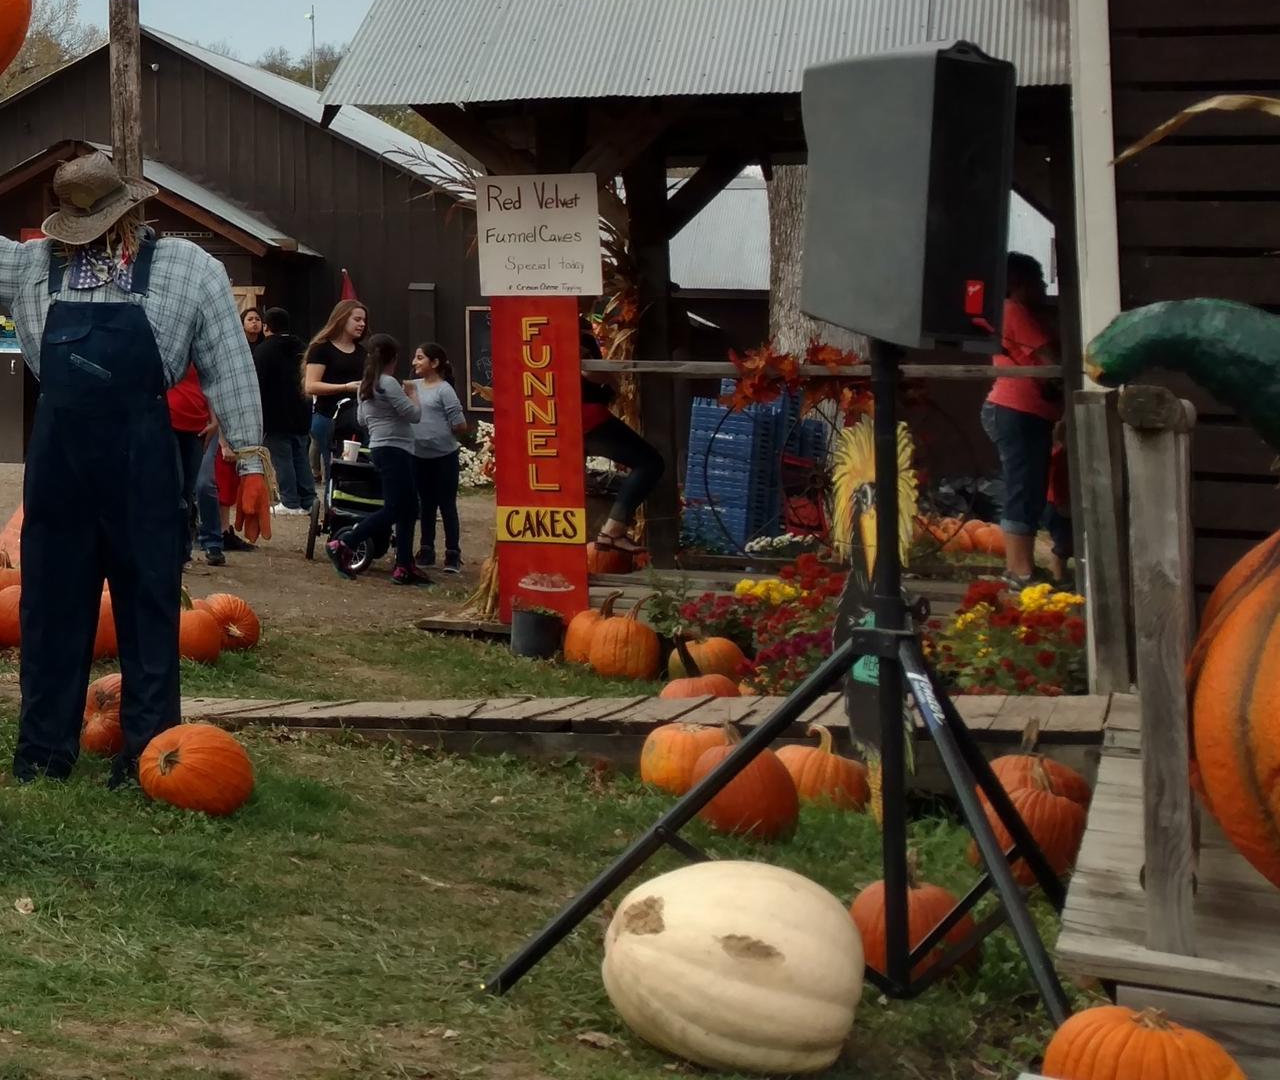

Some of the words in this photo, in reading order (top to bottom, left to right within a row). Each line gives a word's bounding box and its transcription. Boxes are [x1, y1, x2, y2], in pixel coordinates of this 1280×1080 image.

[487, 184, 522, 212] Red
[533, 181, 581, 210] Velvet
[485, 225, 537, 244] Funnel
[504, 255, 552, 275] Special
[521, 316, 561, 492] FUNNEL
[505, 509, 578, 539] CAKES
